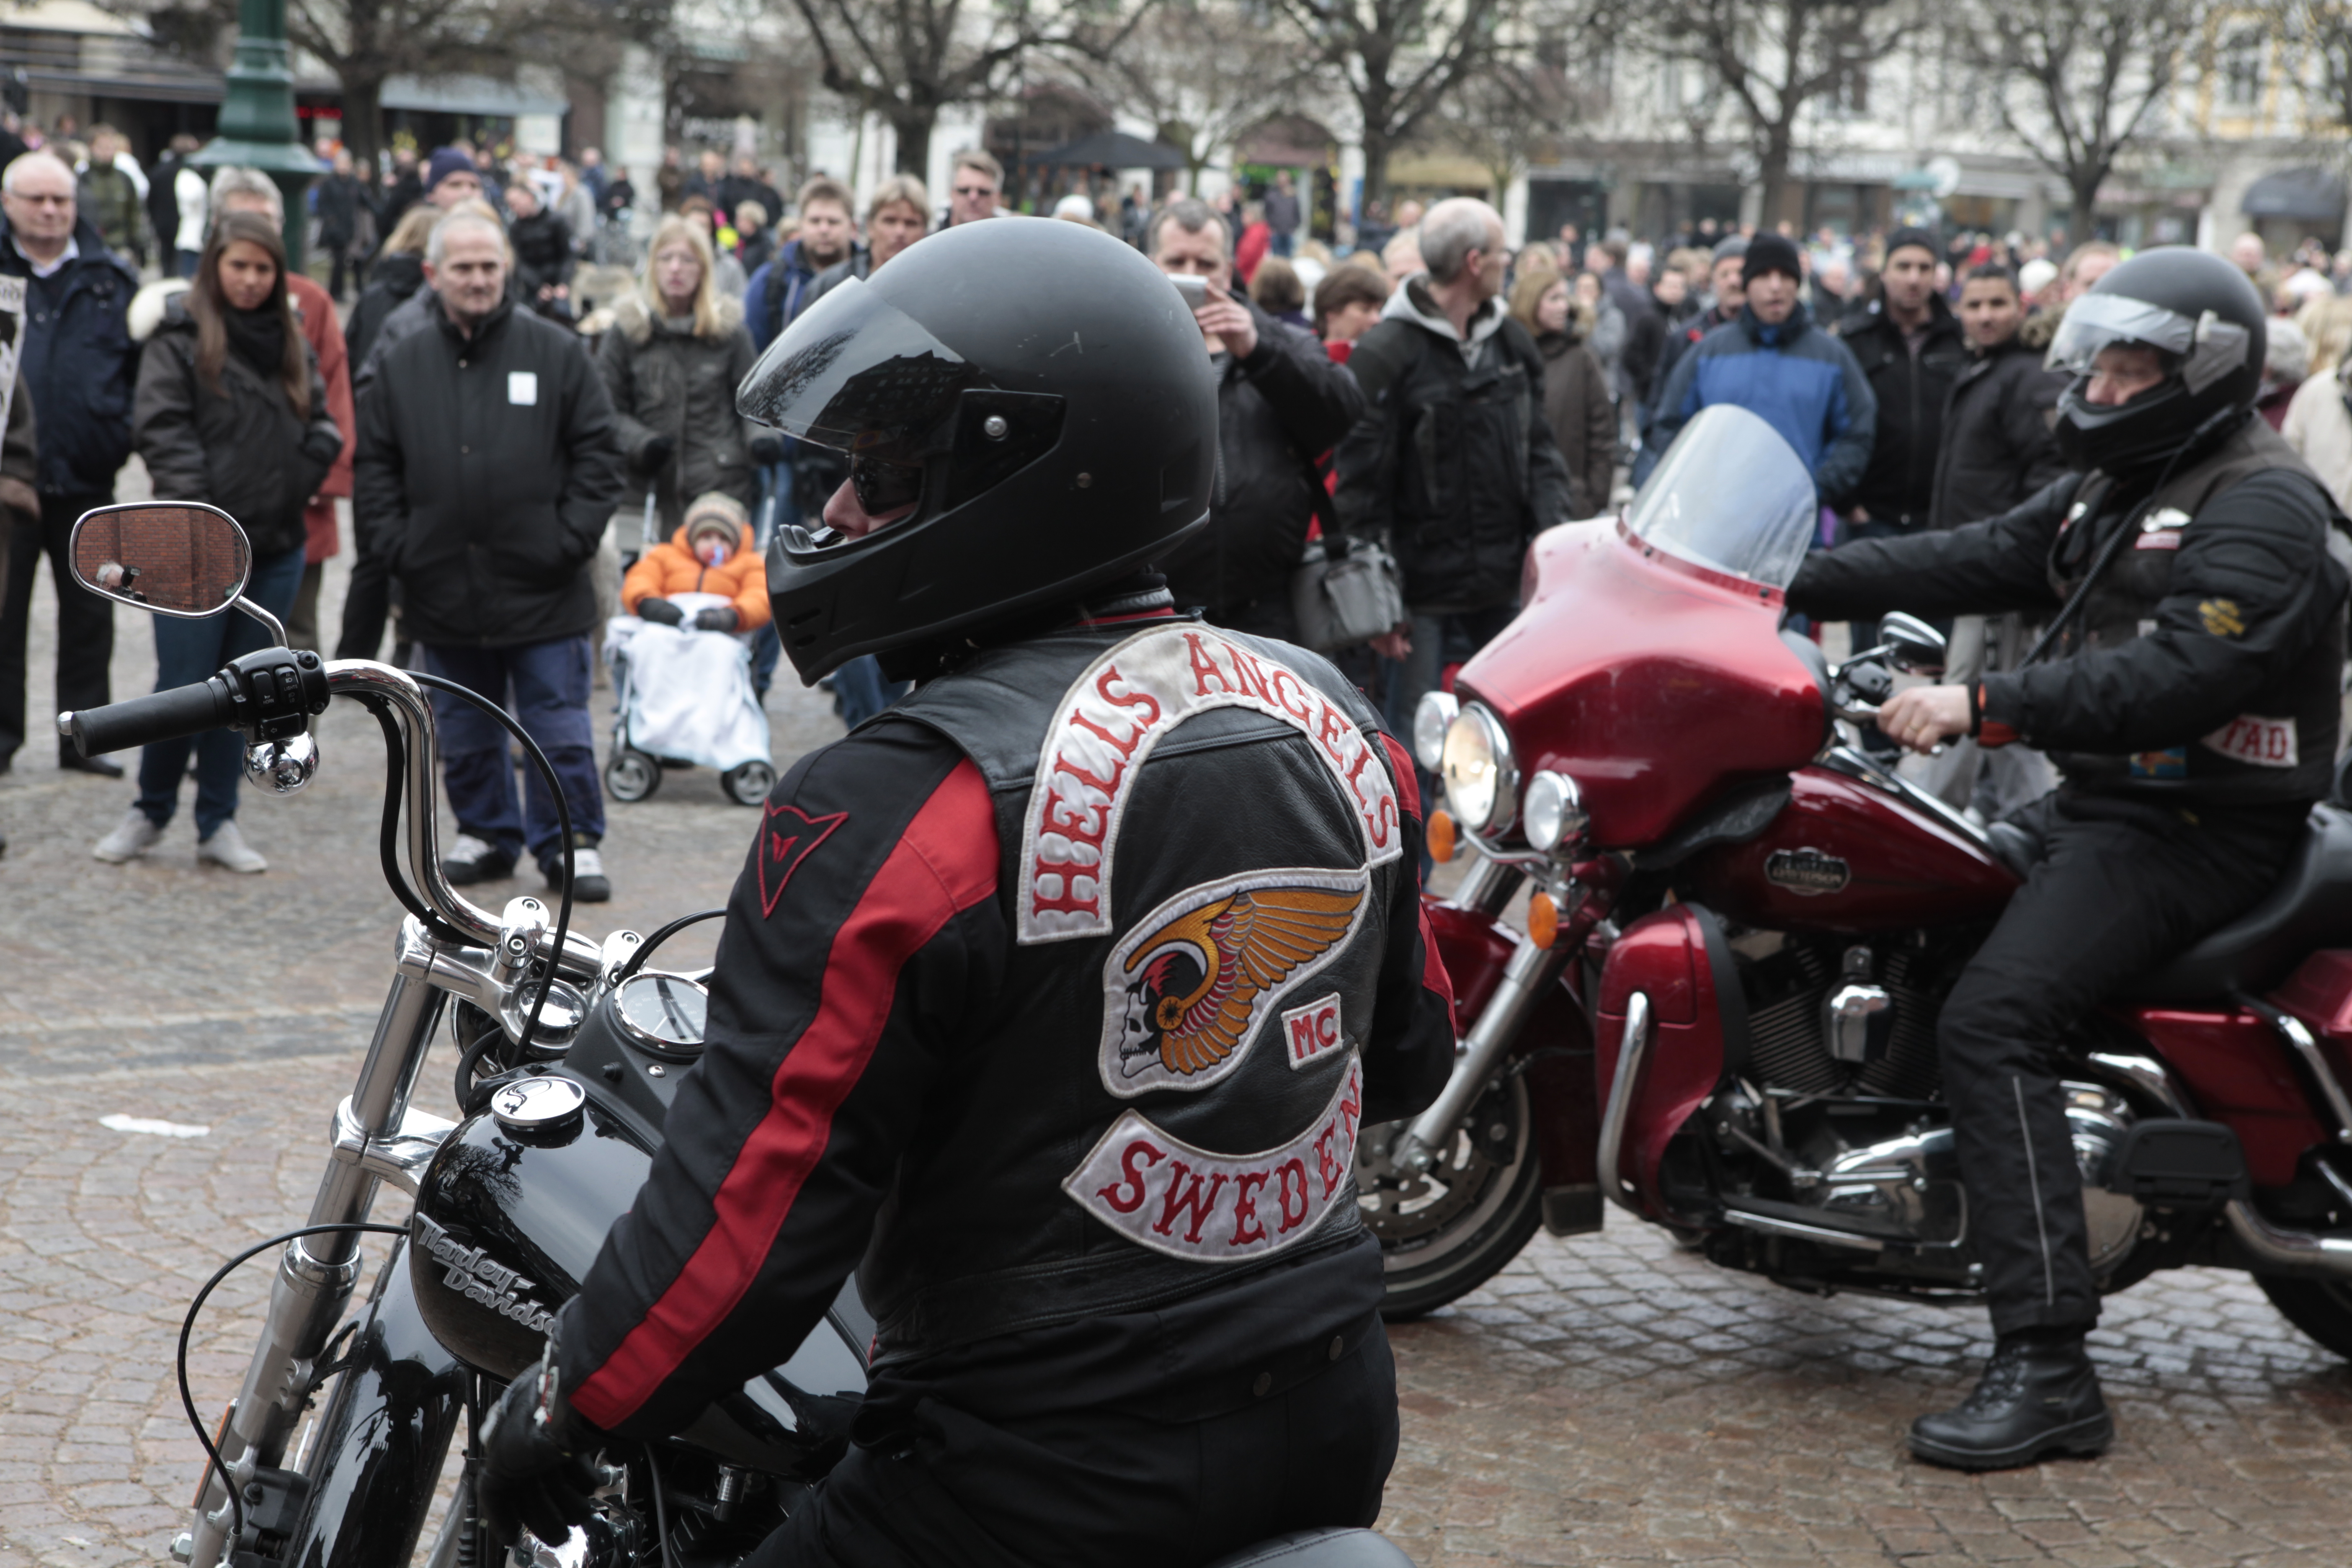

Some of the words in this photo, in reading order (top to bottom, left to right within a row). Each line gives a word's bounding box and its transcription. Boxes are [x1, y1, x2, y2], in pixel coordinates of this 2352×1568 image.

[91, 577, 110, 587] OBJECTS
[1033, 665, 1161, 920] HELLS
[1183, 633, 1399, 848] ANGELS
[1291, 1007, 1337, 1058] MC
[1096, 1068, 1360, 1246] SWEDEN
[433, 1256, 555, 1336] Davidso
